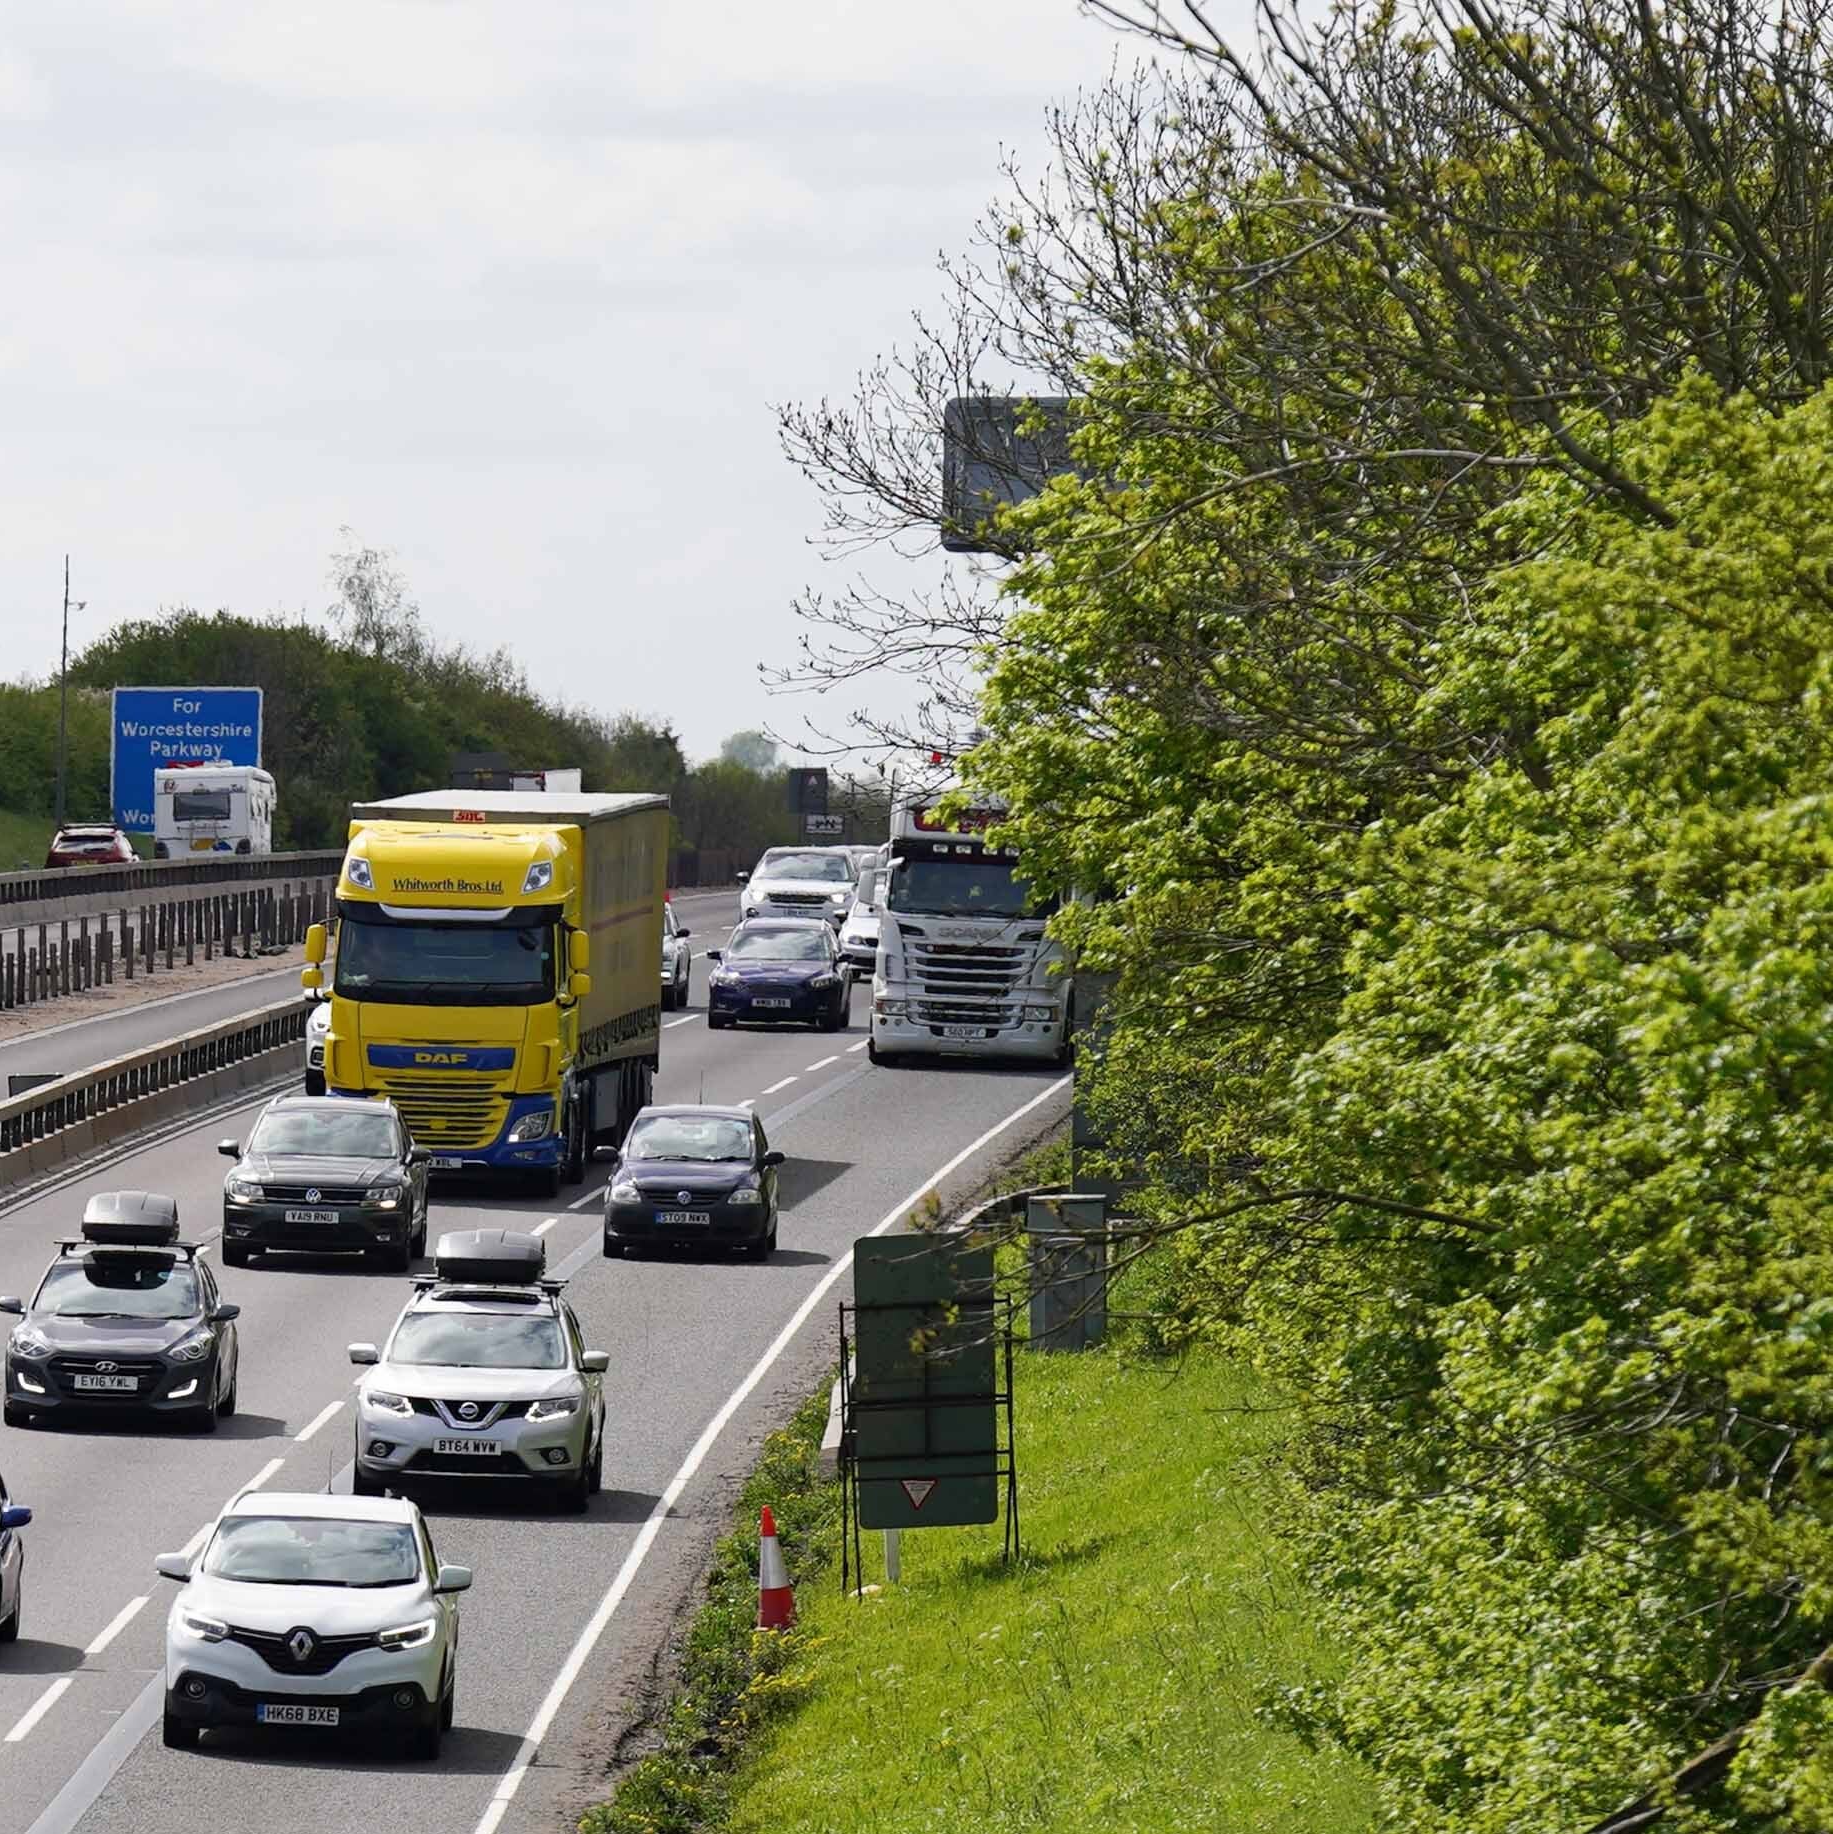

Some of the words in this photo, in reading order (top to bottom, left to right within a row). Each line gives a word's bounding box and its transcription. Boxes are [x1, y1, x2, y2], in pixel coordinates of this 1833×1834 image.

[172, 697, 202, 714] For
[121, 721, 252, 737] Worcestershire
[150, 741, 223, 759] Parkway
[394, 878, 454, 891] Whitworth
[414, 1053, 468, 1064] DAF
[81, 1376, 105, 1387] EY16
[108, 1377, 131, 1387] YWL
[439, 1440, 469, 1452] BT64
[266, 1707, 304, 1721] HK68
[307, 1708, 336, 1722] BXE
